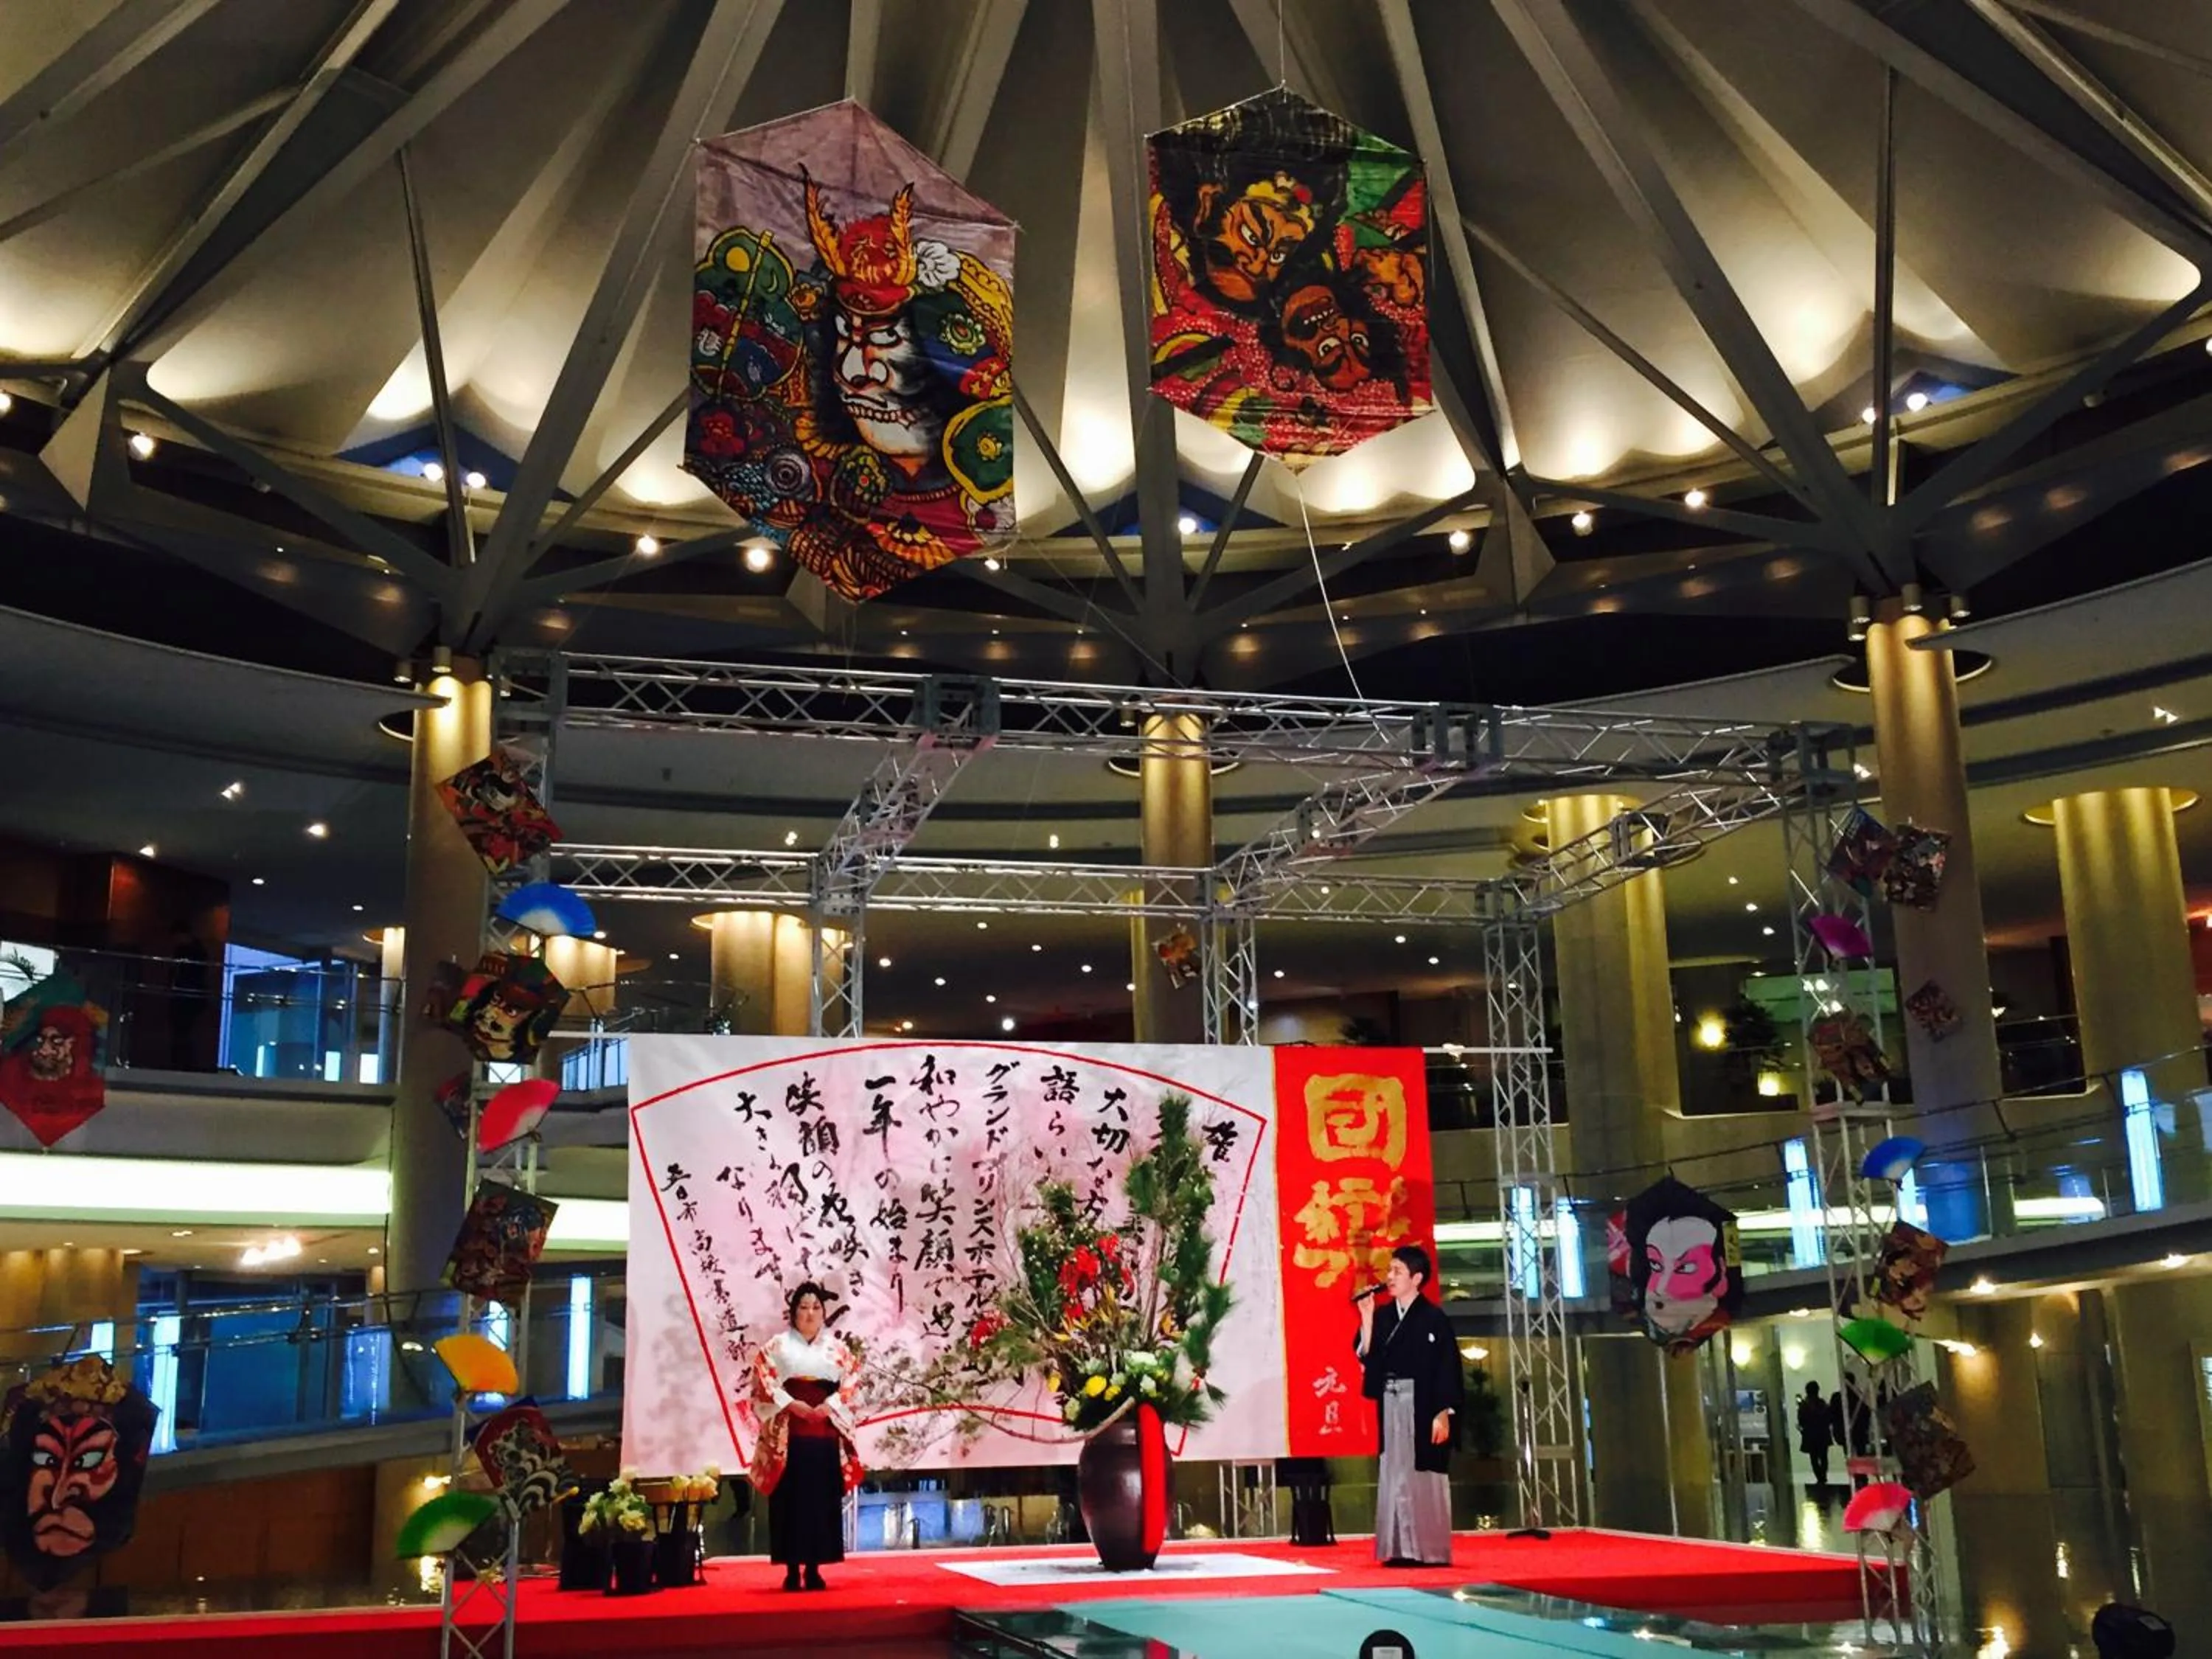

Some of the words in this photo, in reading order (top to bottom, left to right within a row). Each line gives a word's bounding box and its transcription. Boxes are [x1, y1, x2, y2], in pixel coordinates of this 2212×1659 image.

[863, 1076, 909, 1313] 一年の始まり
[962, 1060, 1020, 1336] グランドプリンスホテル
